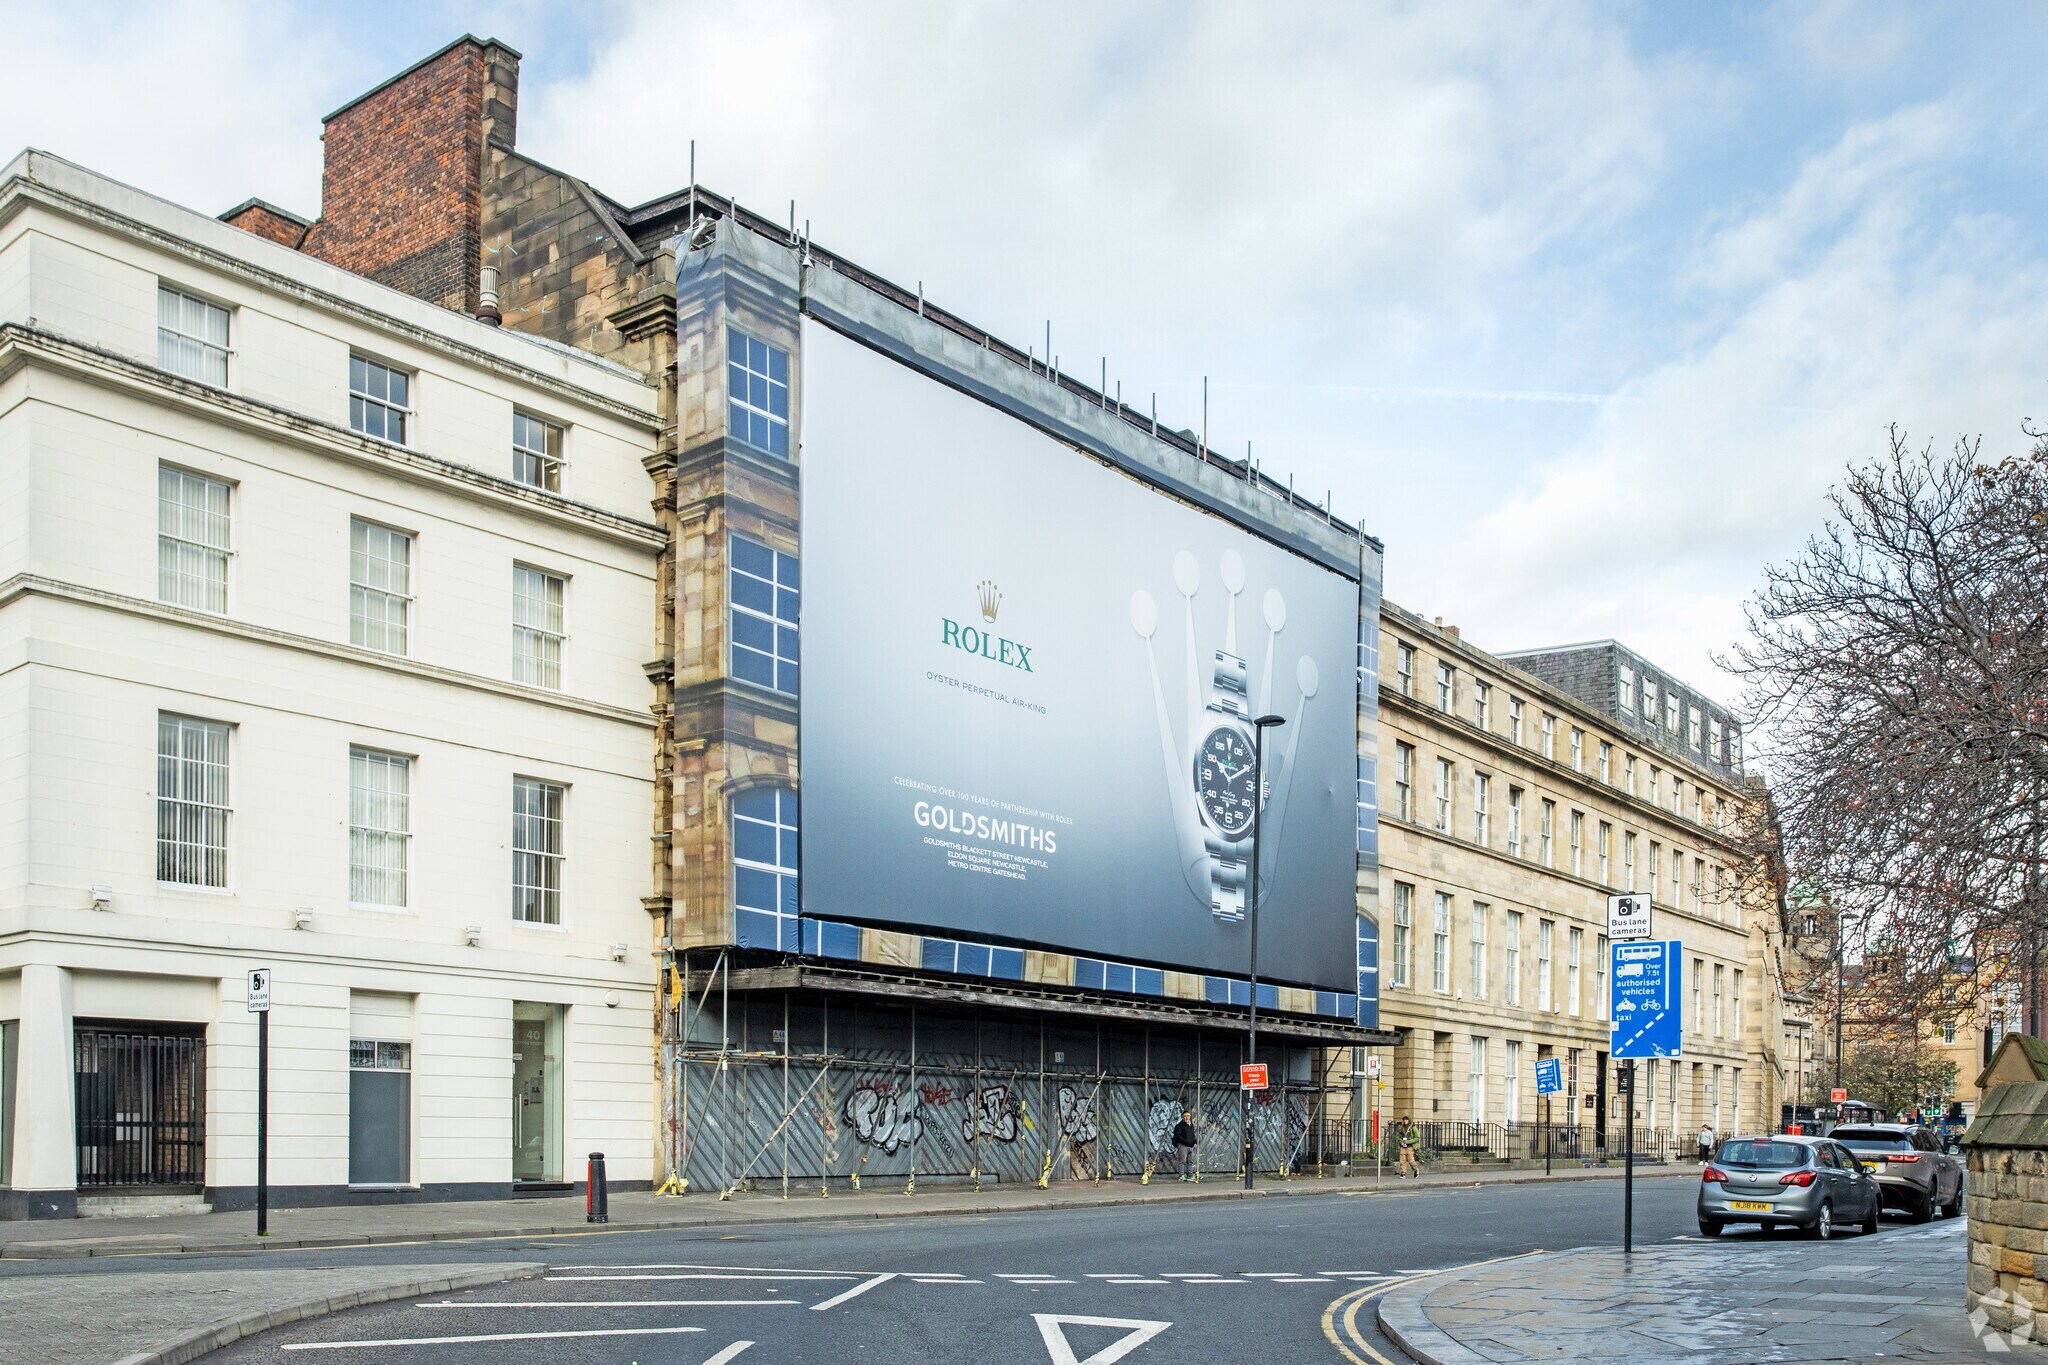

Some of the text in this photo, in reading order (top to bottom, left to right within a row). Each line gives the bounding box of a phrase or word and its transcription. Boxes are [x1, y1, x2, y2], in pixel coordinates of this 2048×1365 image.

[941, 617, 1033, 673] ROLEX
[926, 671, 1047, 715] OYSTER PERPETUAL AIR-KING
[1234, 747, 1243, 756] 05
[1204, 769, 1212, 780] 9
[1246, 780, 1253, 792] 3
[1207, 790, 1216, 798] 40
[894, 776, 1074, 825] CELEBRATING OVER 100 YEARS OF PARTNERSHIP WITH ROLEX
[1242, 799, 1250, 807] 20
[1225, 812, 1232, 824] 6
[914, 801, 1057, 853] GOLDSMITHS
[923, 836, 1049, 869] GOLDSMITHS BLACKETT STREET NEWCASTLE,
[947, 850, 1027, 873] ELDON SQUARE NEWCASTLE,
[947, 859, 1027, 880] METRO CENTRE GATESHEAD.
[1629, 918, 1647, 926] lane
[1611, 927, 1647, 935] cameras
[1616, 979, 1660, 987] authorised
[1621, 987, 1655, 996] vehicles
[1616, 1013, 1632, 1021] taxi
[526, 1030, 540, 1040] 40
